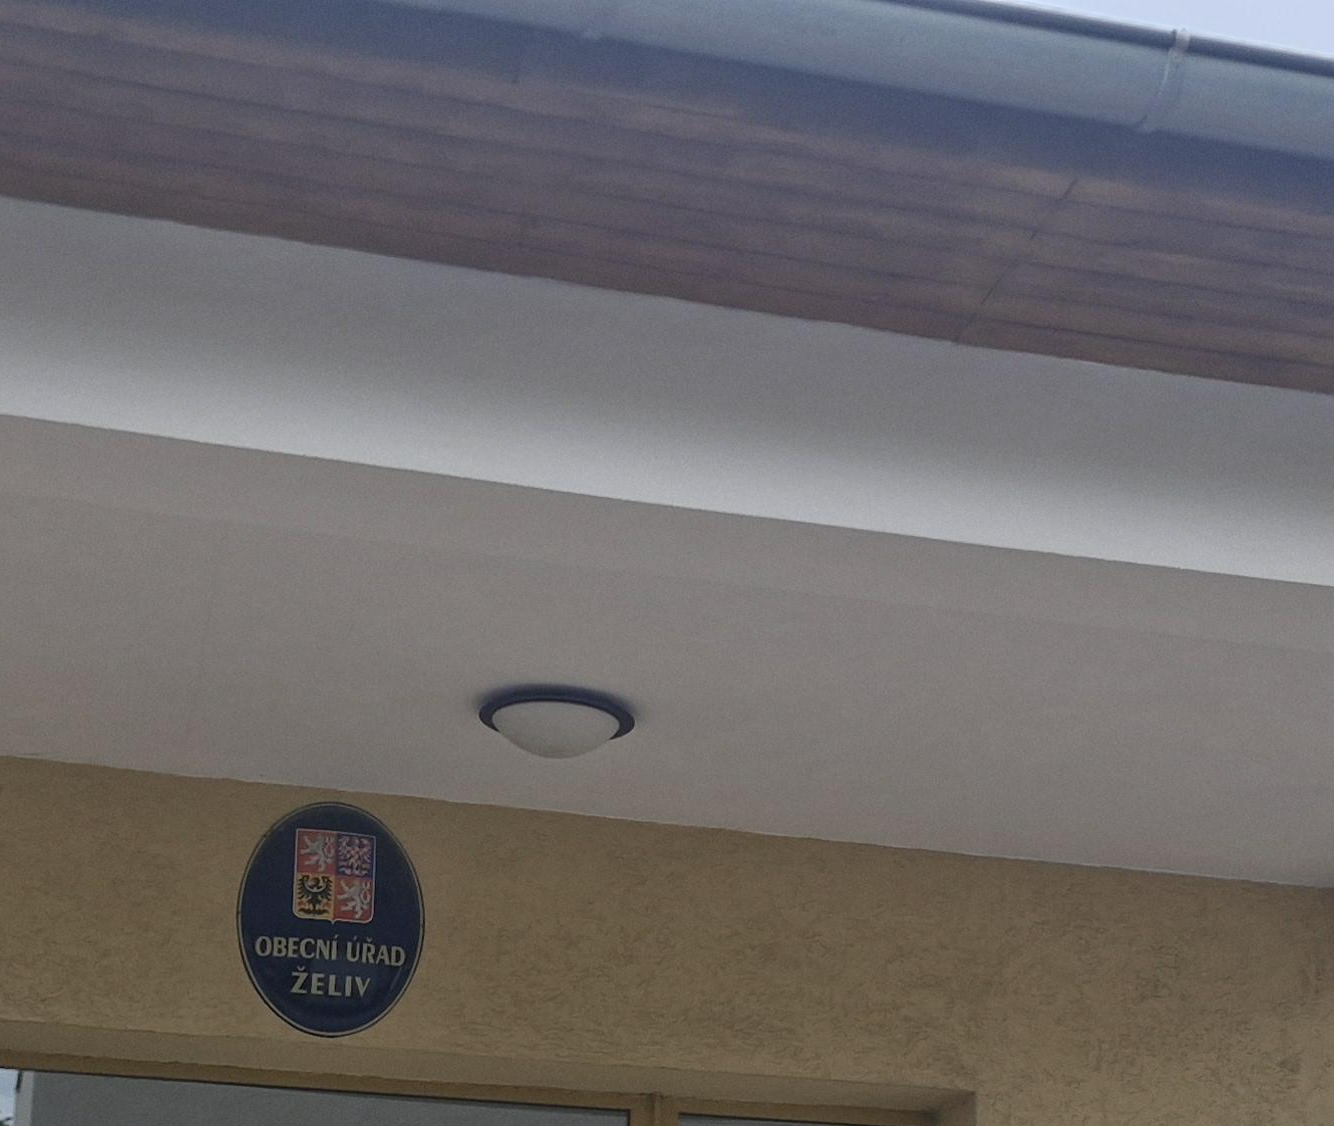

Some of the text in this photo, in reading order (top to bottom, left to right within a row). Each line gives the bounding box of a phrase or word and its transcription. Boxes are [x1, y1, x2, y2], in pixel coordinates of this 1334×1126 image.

[254, 934, 406, 967] OBECNÍ ÚŘAD
[290, 965, 372, 997] ŽELIV
